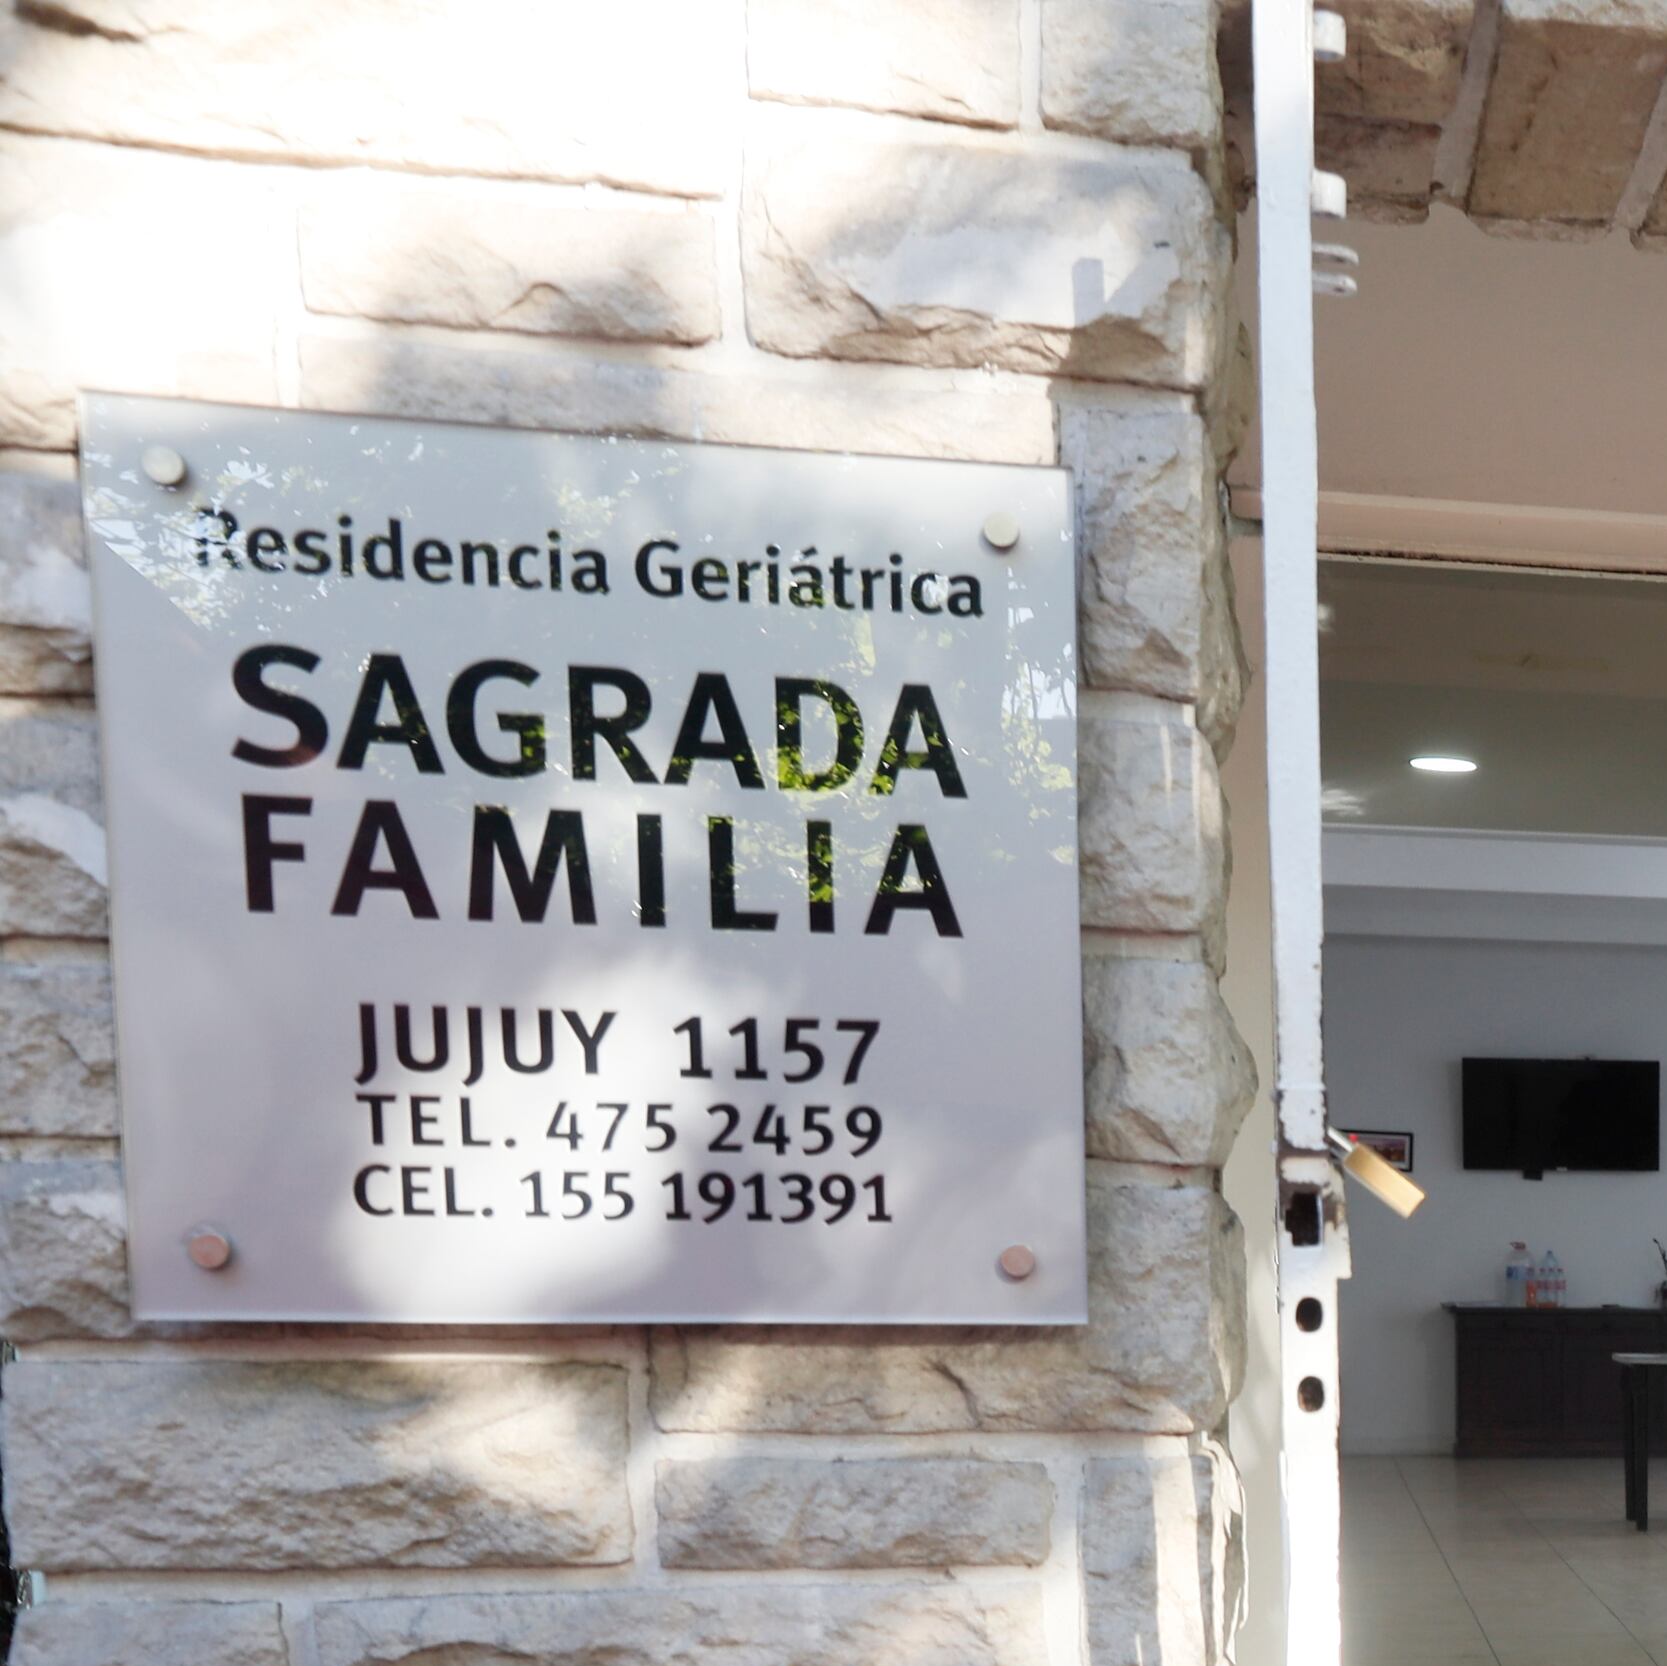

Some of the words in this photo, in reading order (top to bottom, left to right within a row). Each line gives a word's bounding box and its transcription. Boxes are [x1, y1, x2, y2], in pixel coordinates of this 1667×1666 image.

[196, 507, 611, 596] Residencia
[634, 539, 984, 618] Geriátrica
[230, 643, 969, 801] SAGRADA
[241, 794, 966, 939] FAMILIA
[354, 1003, 618, 1087] JUJUY
[673, 1016, 882, 1086] 1157
[355, 1093, 518, 1148] TEL.
[545, 1101, 677, 1153] 475
[707, 1103, 883, 1158] 2459
[353, 1164, 494, 1219] CEL.
[519, 1170, 635, 1221] 155
[661, 1172, 893, 1226] 191391
